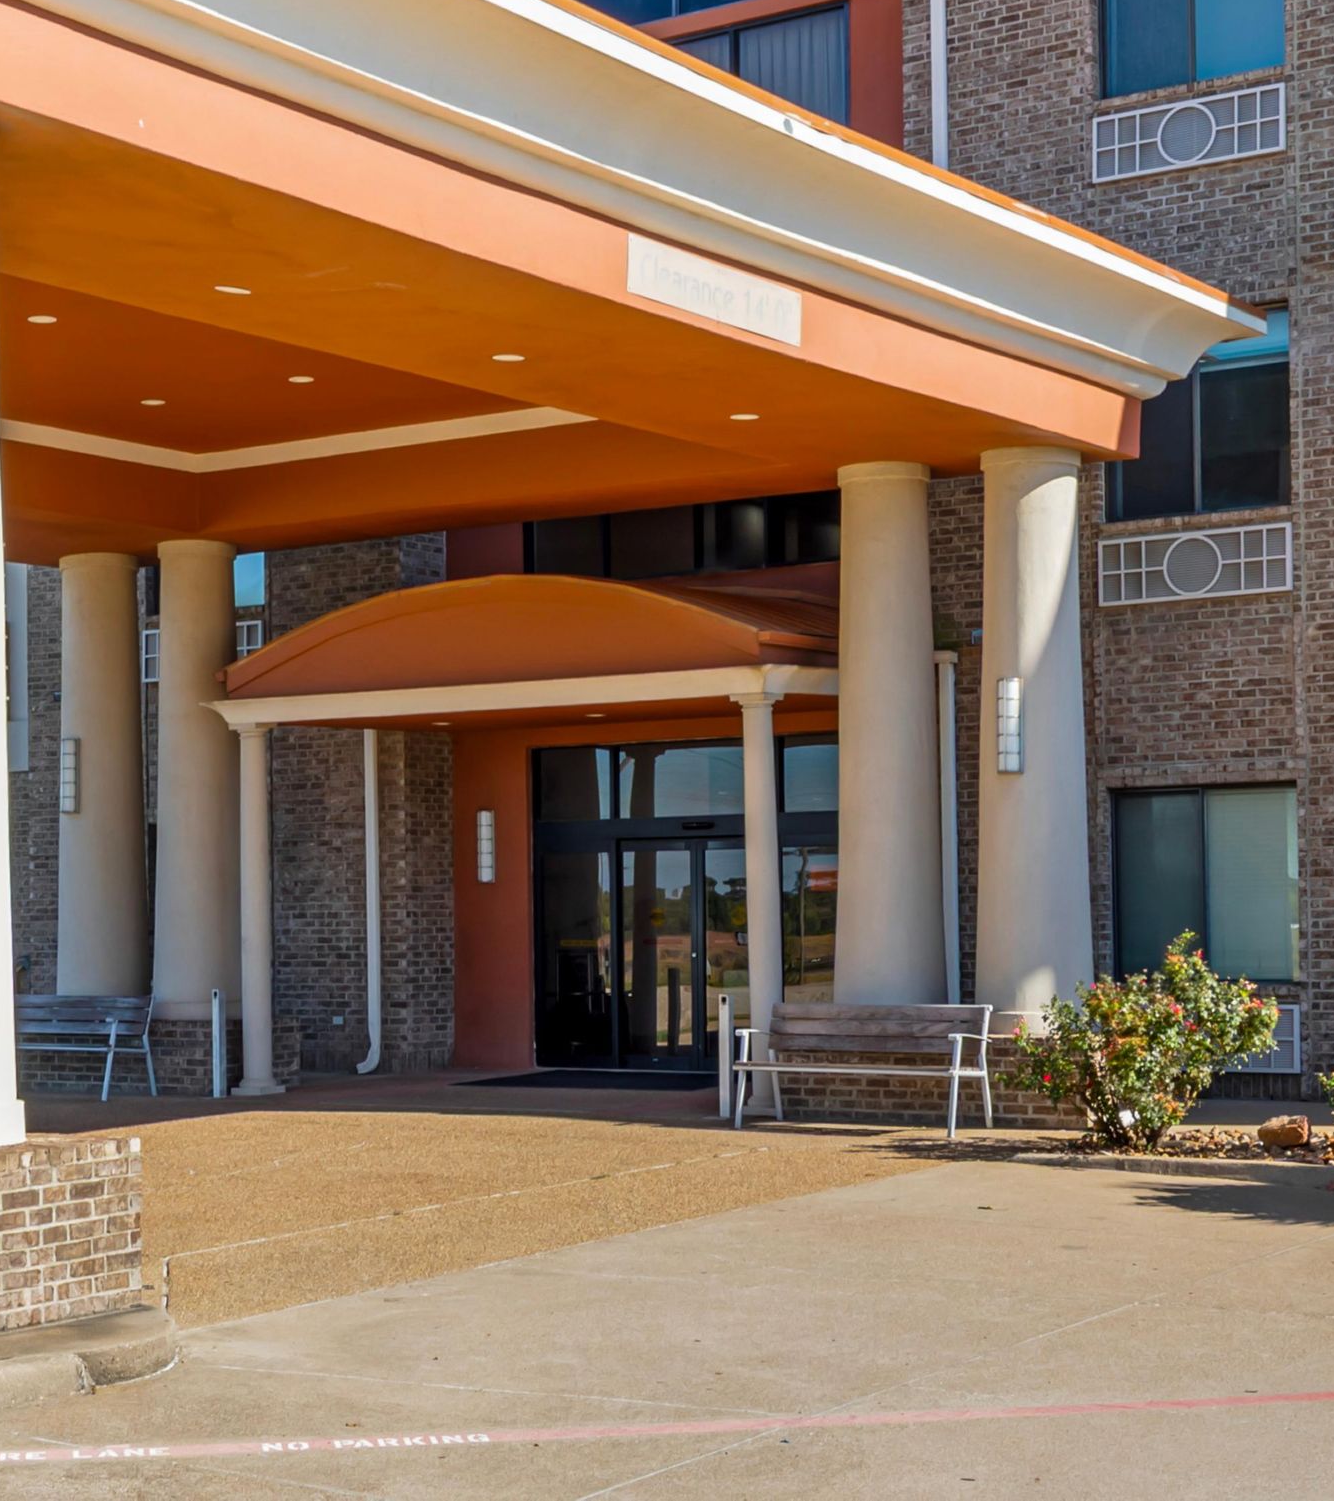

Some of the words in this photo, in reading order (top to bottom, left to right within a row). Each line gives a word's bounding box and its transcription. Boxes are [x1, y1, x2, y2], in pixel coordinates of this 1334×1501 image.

[72, 1447, 170, 1459] LANE
[261, 1441, 310, 1452] NO
[332, 1433, 490, 1449] PARKING
